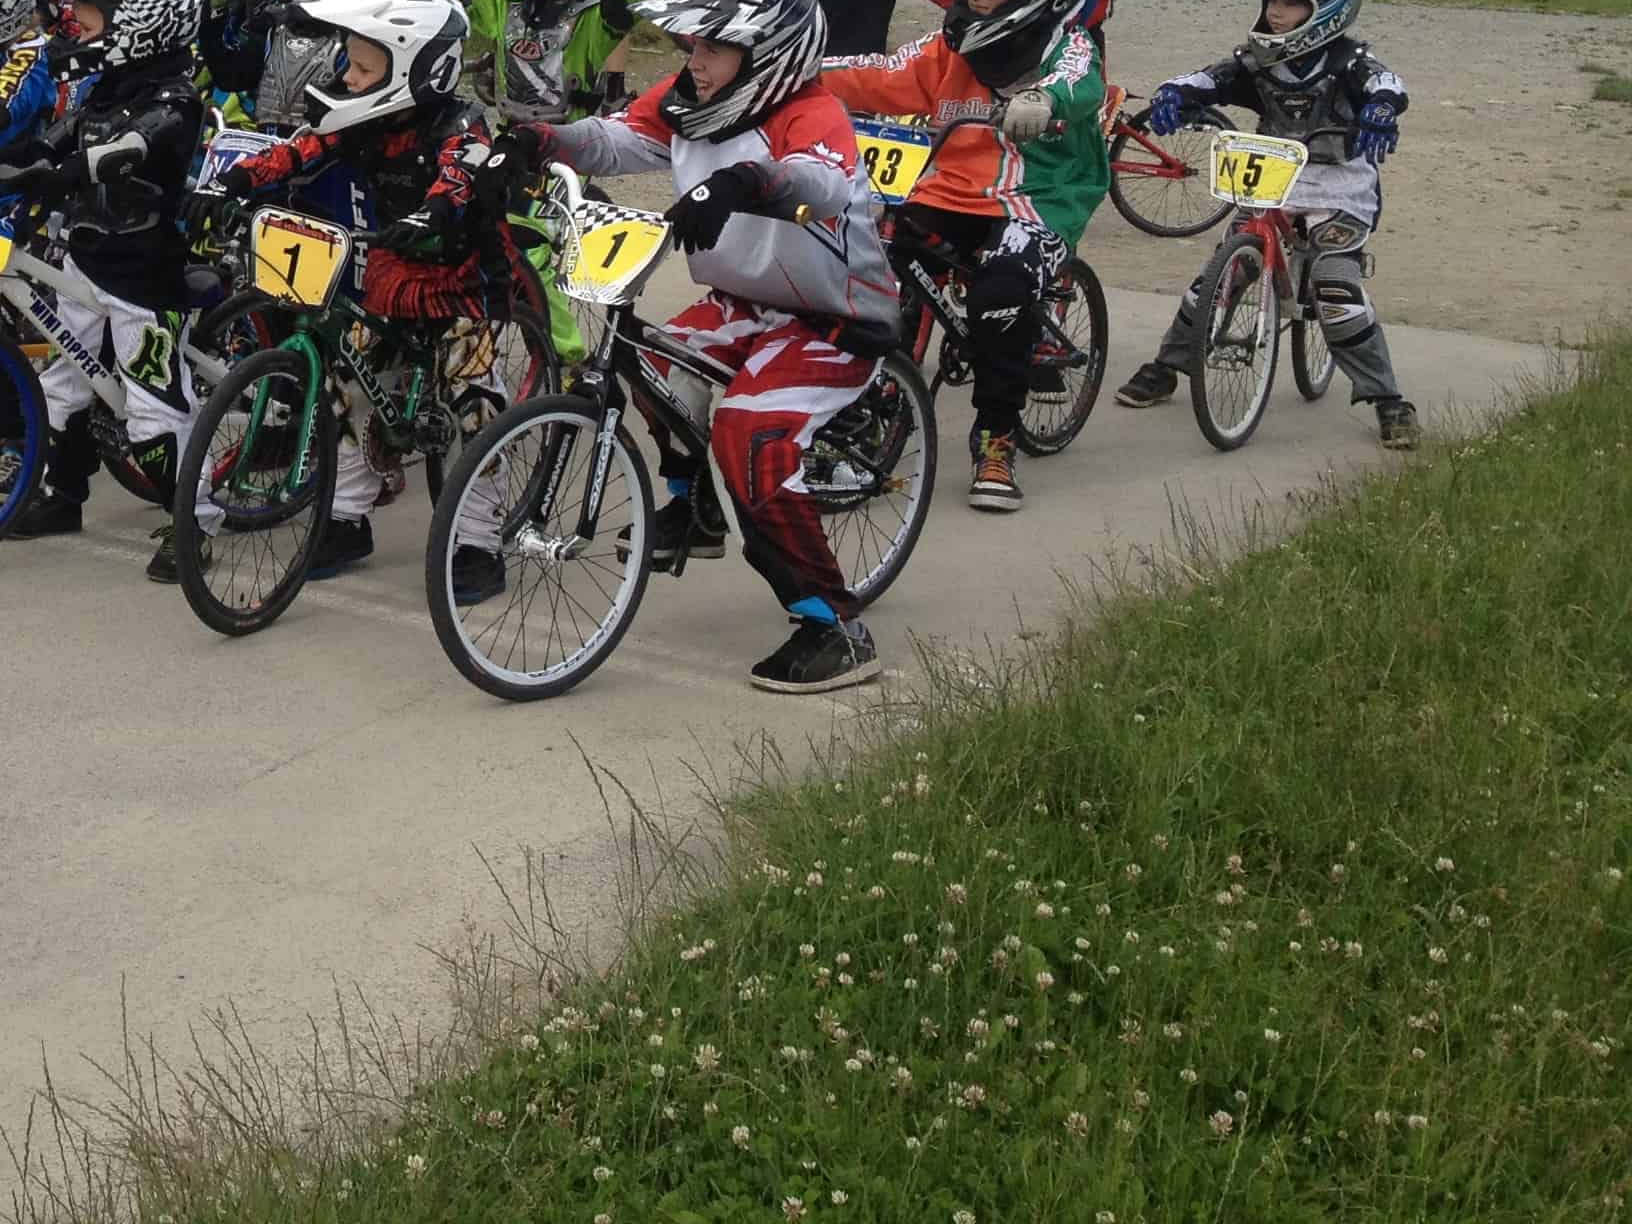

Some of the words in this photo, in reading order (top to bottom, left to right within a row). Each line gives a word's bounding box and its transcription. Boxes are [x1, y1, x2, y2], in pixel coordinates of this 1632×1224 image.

[936, 97, 994, 122] Holla
[1242, 151, 1266, 187] 5
[283, 243, 301, 289] 1
[600, 230, 629, 269] 1
[980, 306, 1022, 321] FOX
